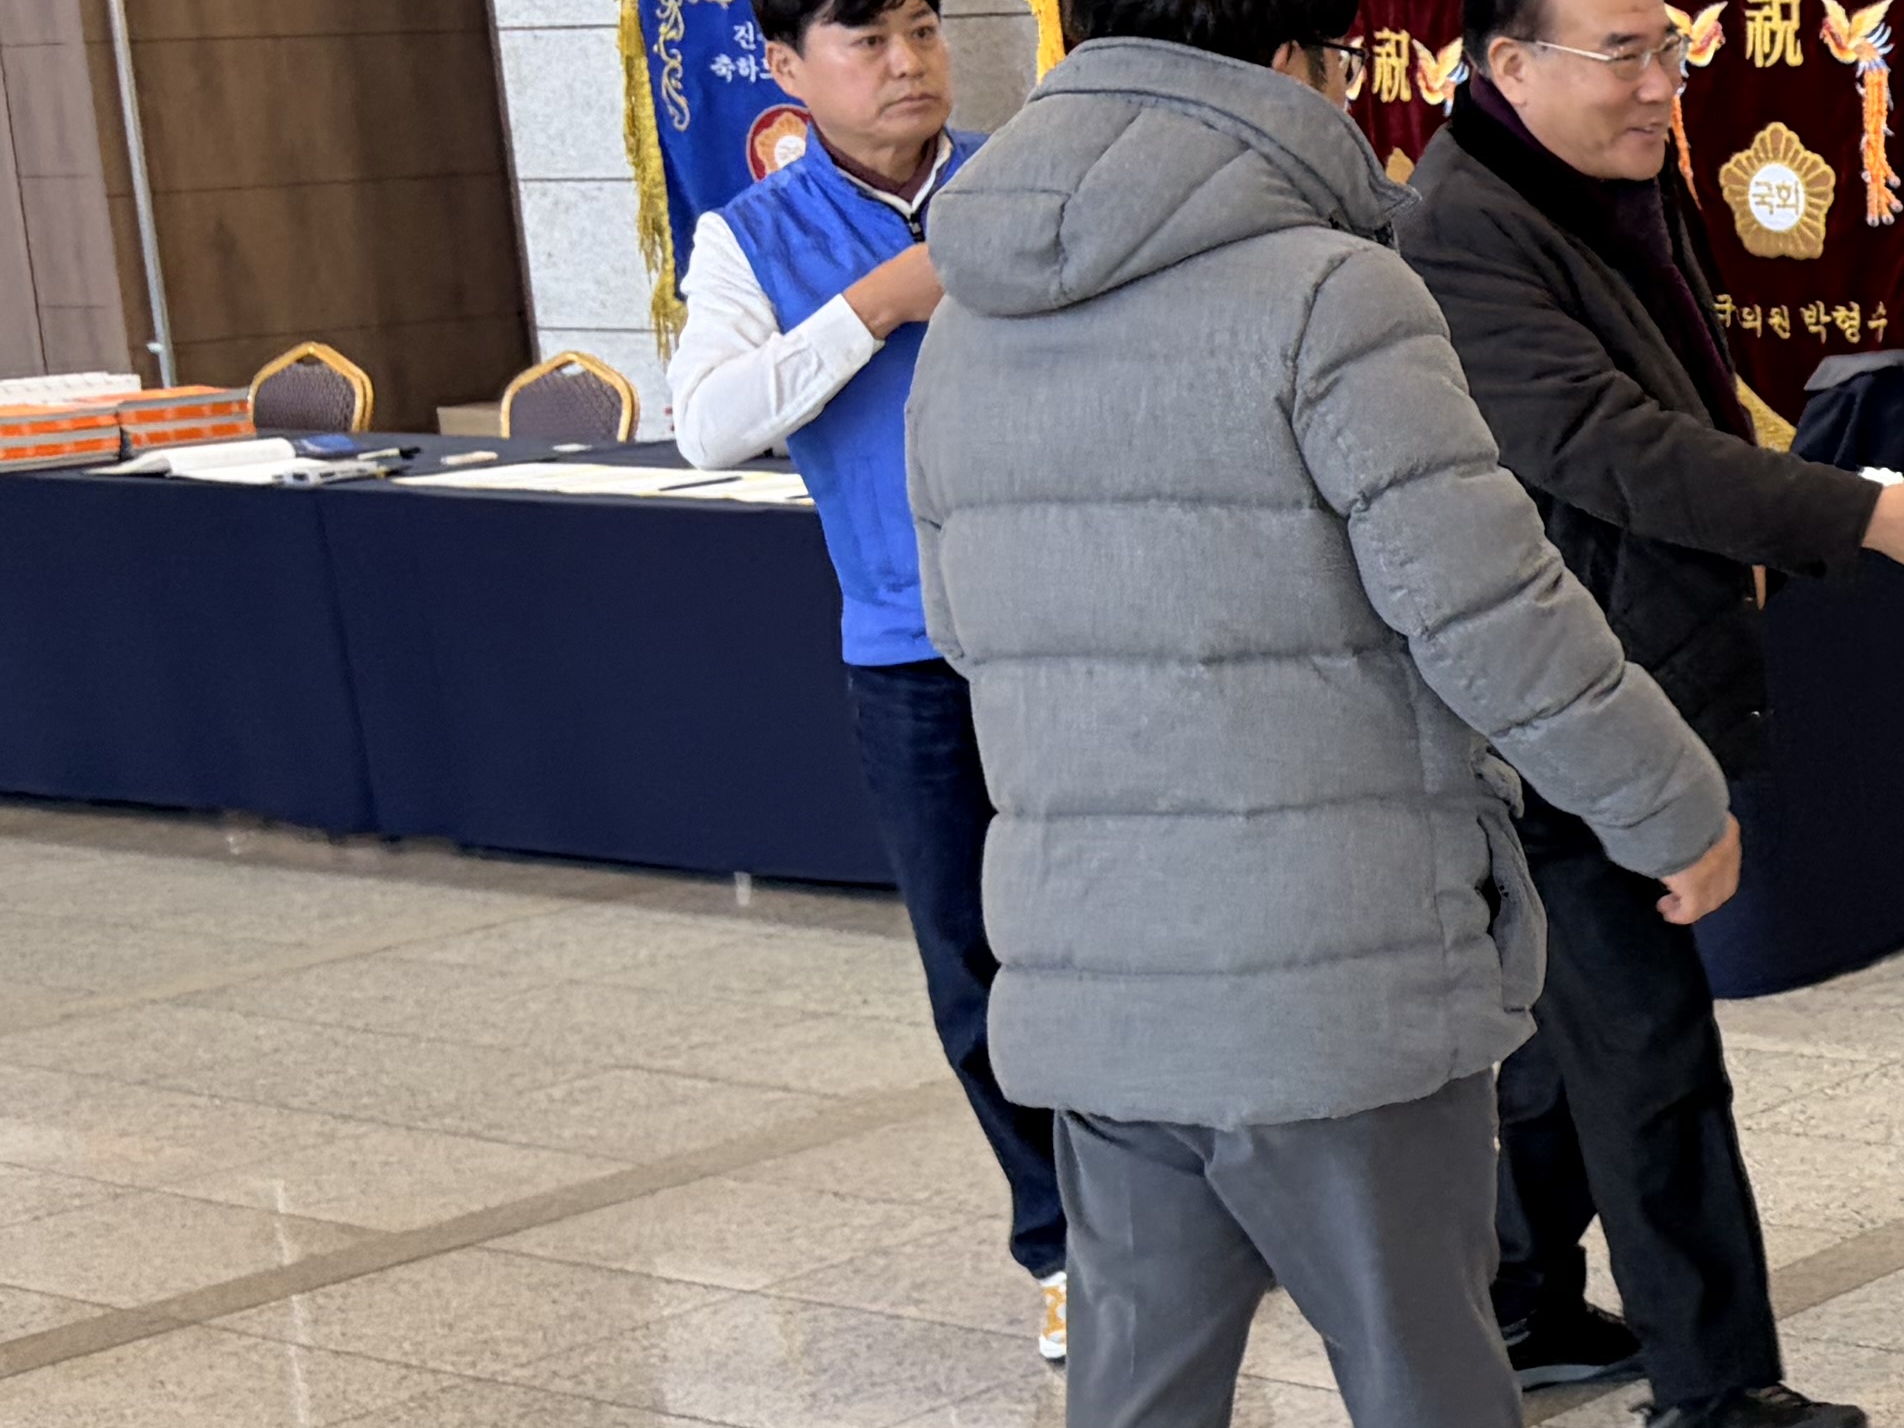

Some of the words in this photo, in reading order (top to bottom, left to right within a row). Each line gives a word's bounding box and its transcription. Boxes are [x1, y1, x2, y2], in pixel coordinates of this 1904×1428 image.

[1371, 26, 1412, 103] 祝
[1751, 180, 1800, 216] 국회
[1799, 300, 1889, 344] 박형수
